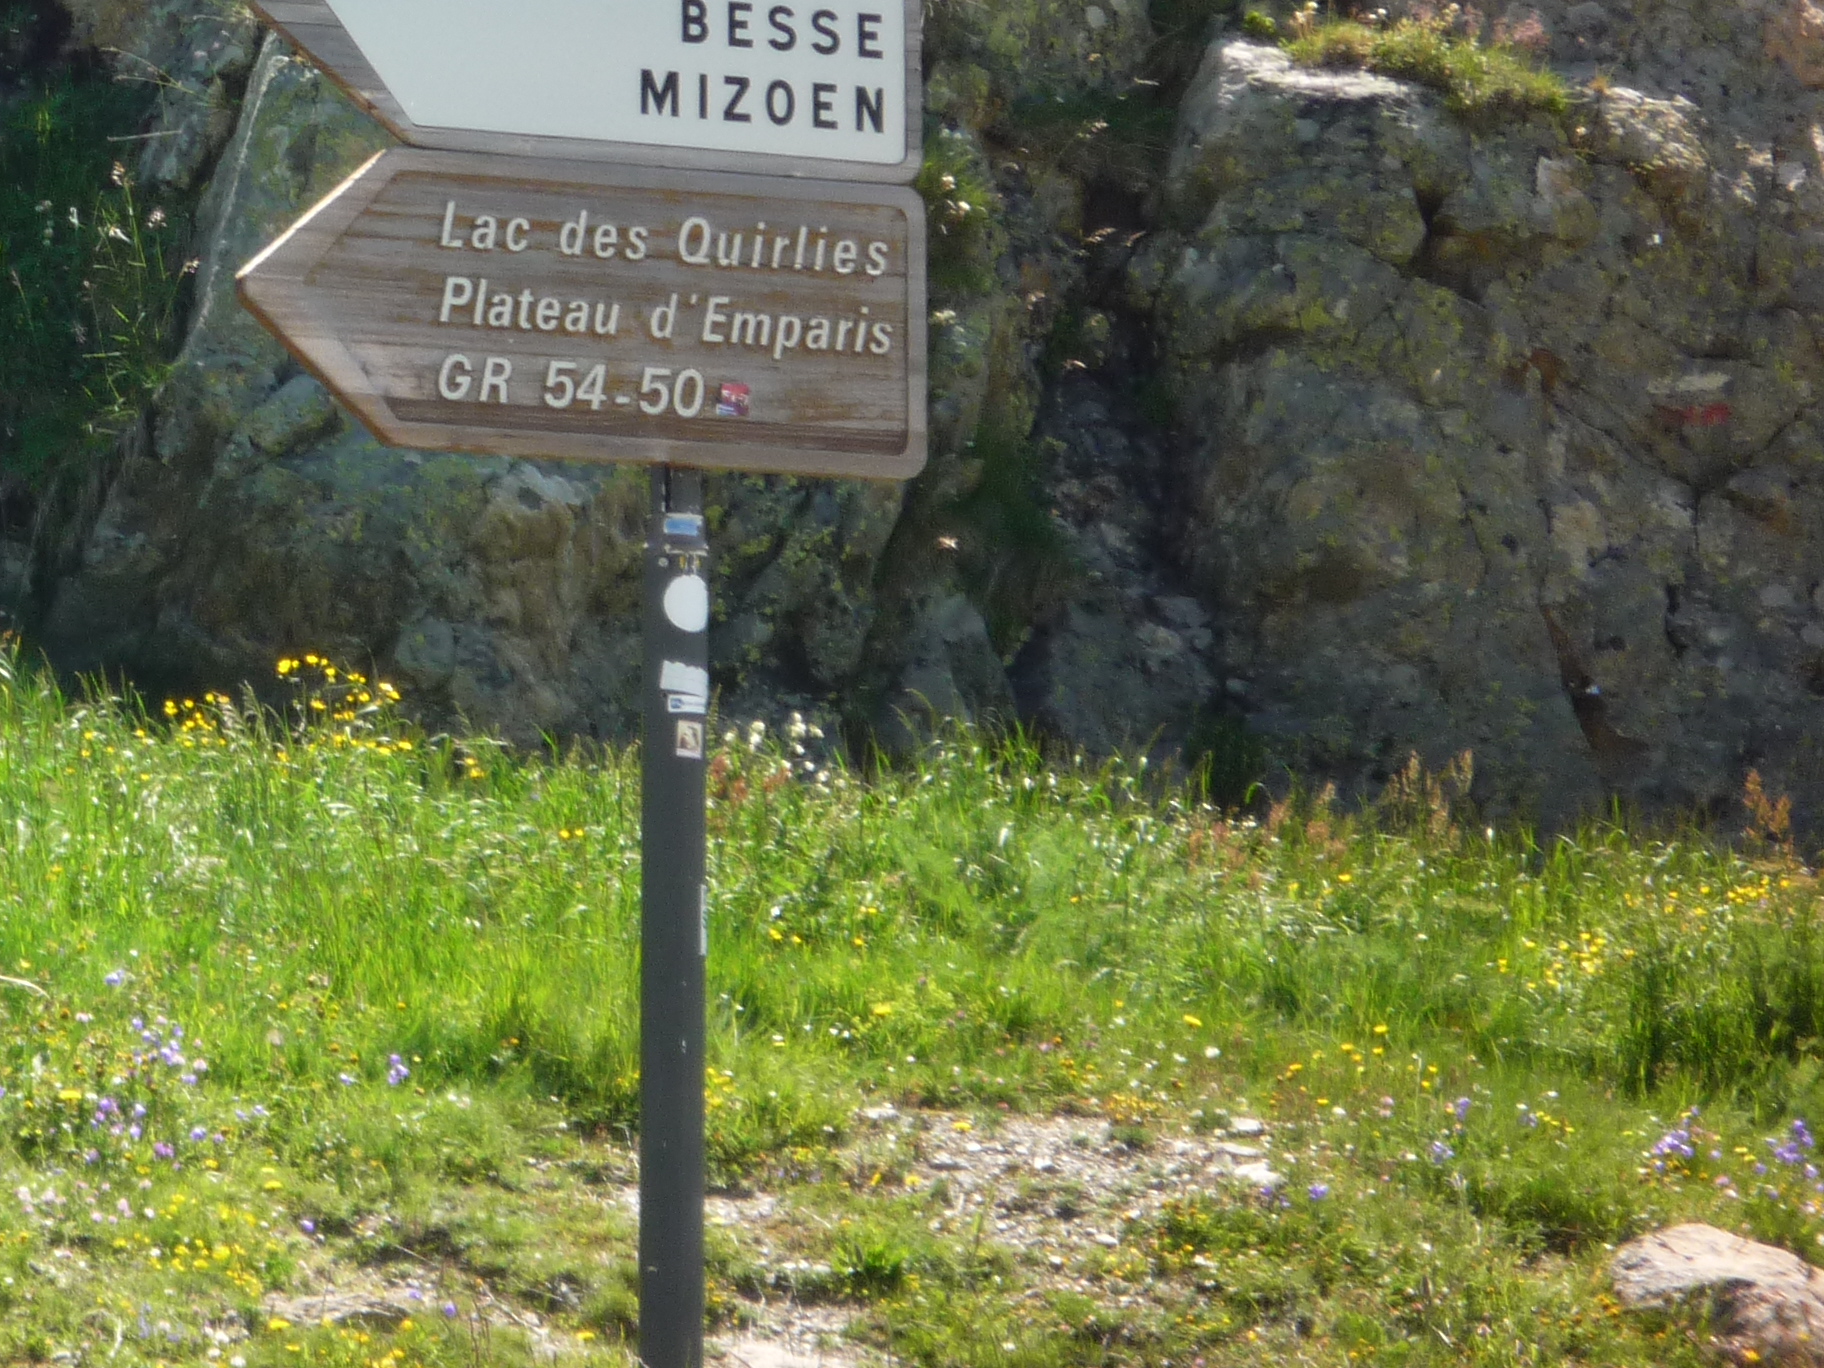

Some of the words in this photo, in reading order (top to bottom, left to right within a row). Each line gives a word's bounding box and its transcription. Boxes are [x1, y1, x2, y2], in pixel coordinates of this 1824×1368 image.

[639, 69, 885, 133] MIZOEN
[440, 201, 530, 253] Lac
[559, 210, 648, 261] des
[677, 217, 889, 277] Quirlies
[439, 277, 619, 335] Plateau
[651, 294, 893, 359] d'Emparis
[438, 354, 511, 404] GR
[544, 364, 705, 419] 54-50
